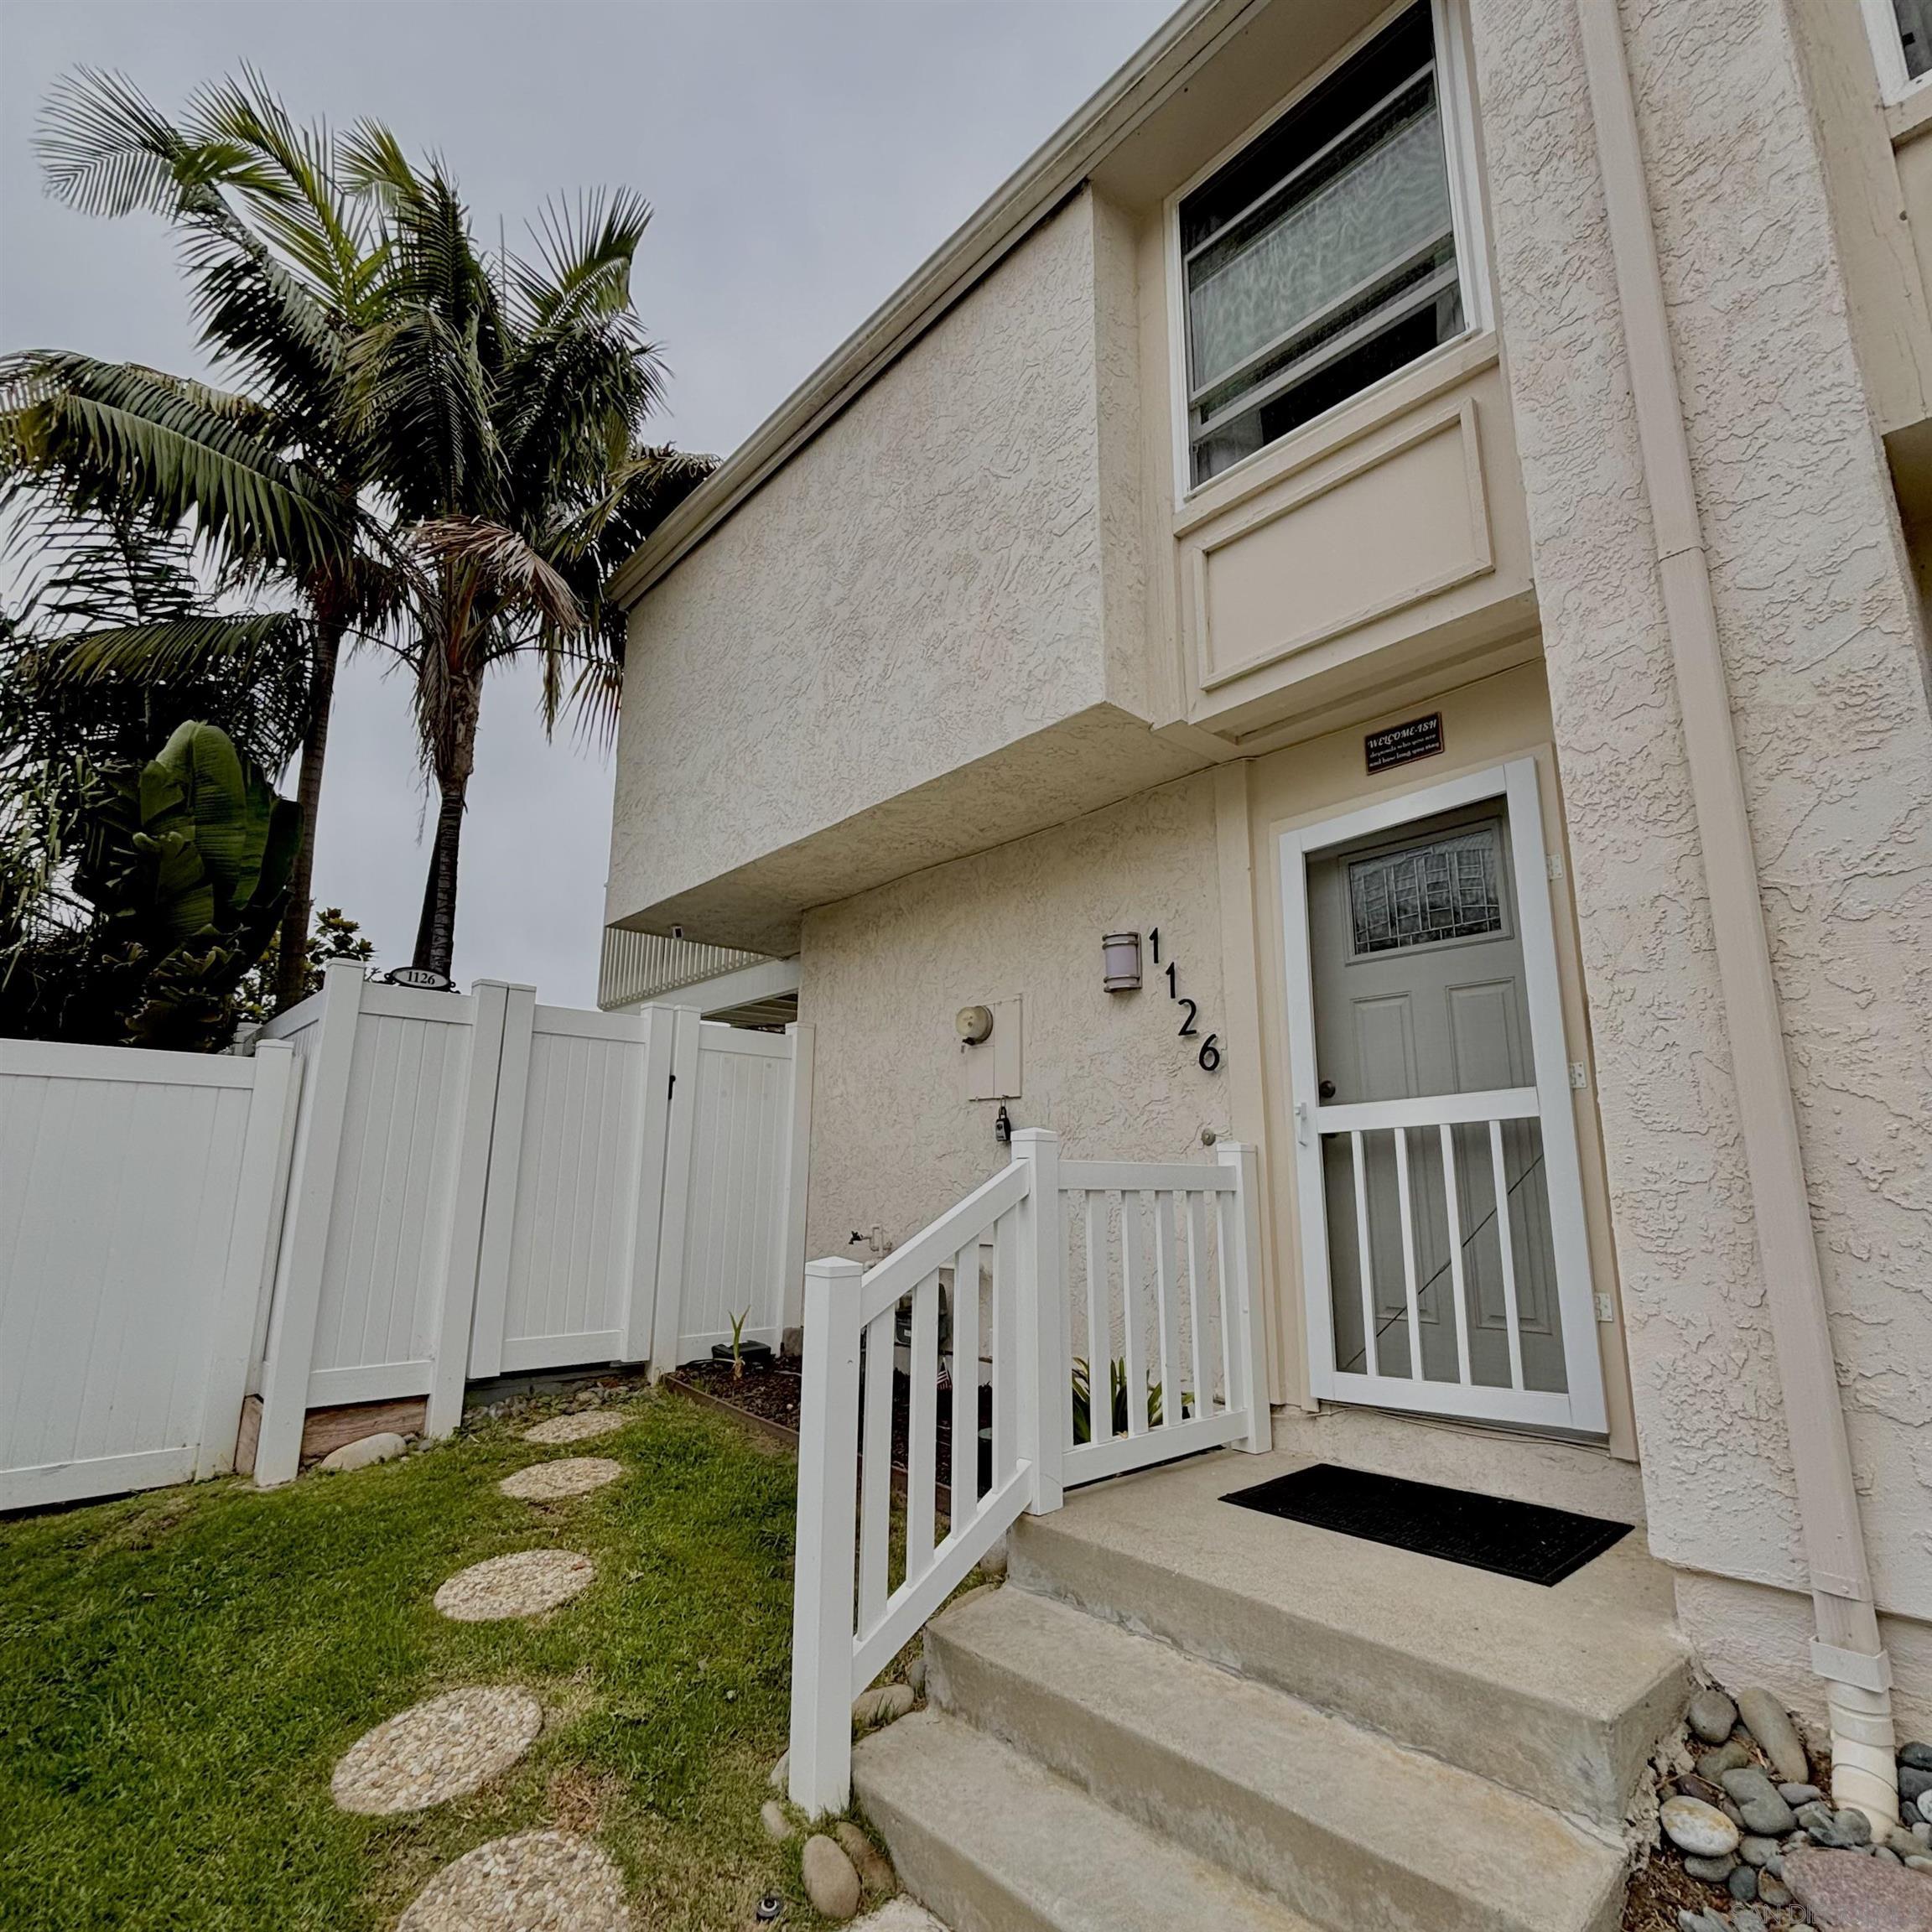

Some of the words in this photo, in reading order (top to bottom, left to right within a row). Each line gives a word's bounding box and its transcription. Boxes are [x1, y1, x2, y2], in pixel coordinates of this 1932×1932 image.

[1368, 719, 1437, 749] WELCOME-ISH
[1368, 758, 1382, 767] and
[1382, 756, 1396, 764] how
[1412, 746, 1425, 755] you
[1425, 741, 1440, 750] stay
[407, 971, 436, 985] 1126
[1149, 927, 1220, 1071] 1126
